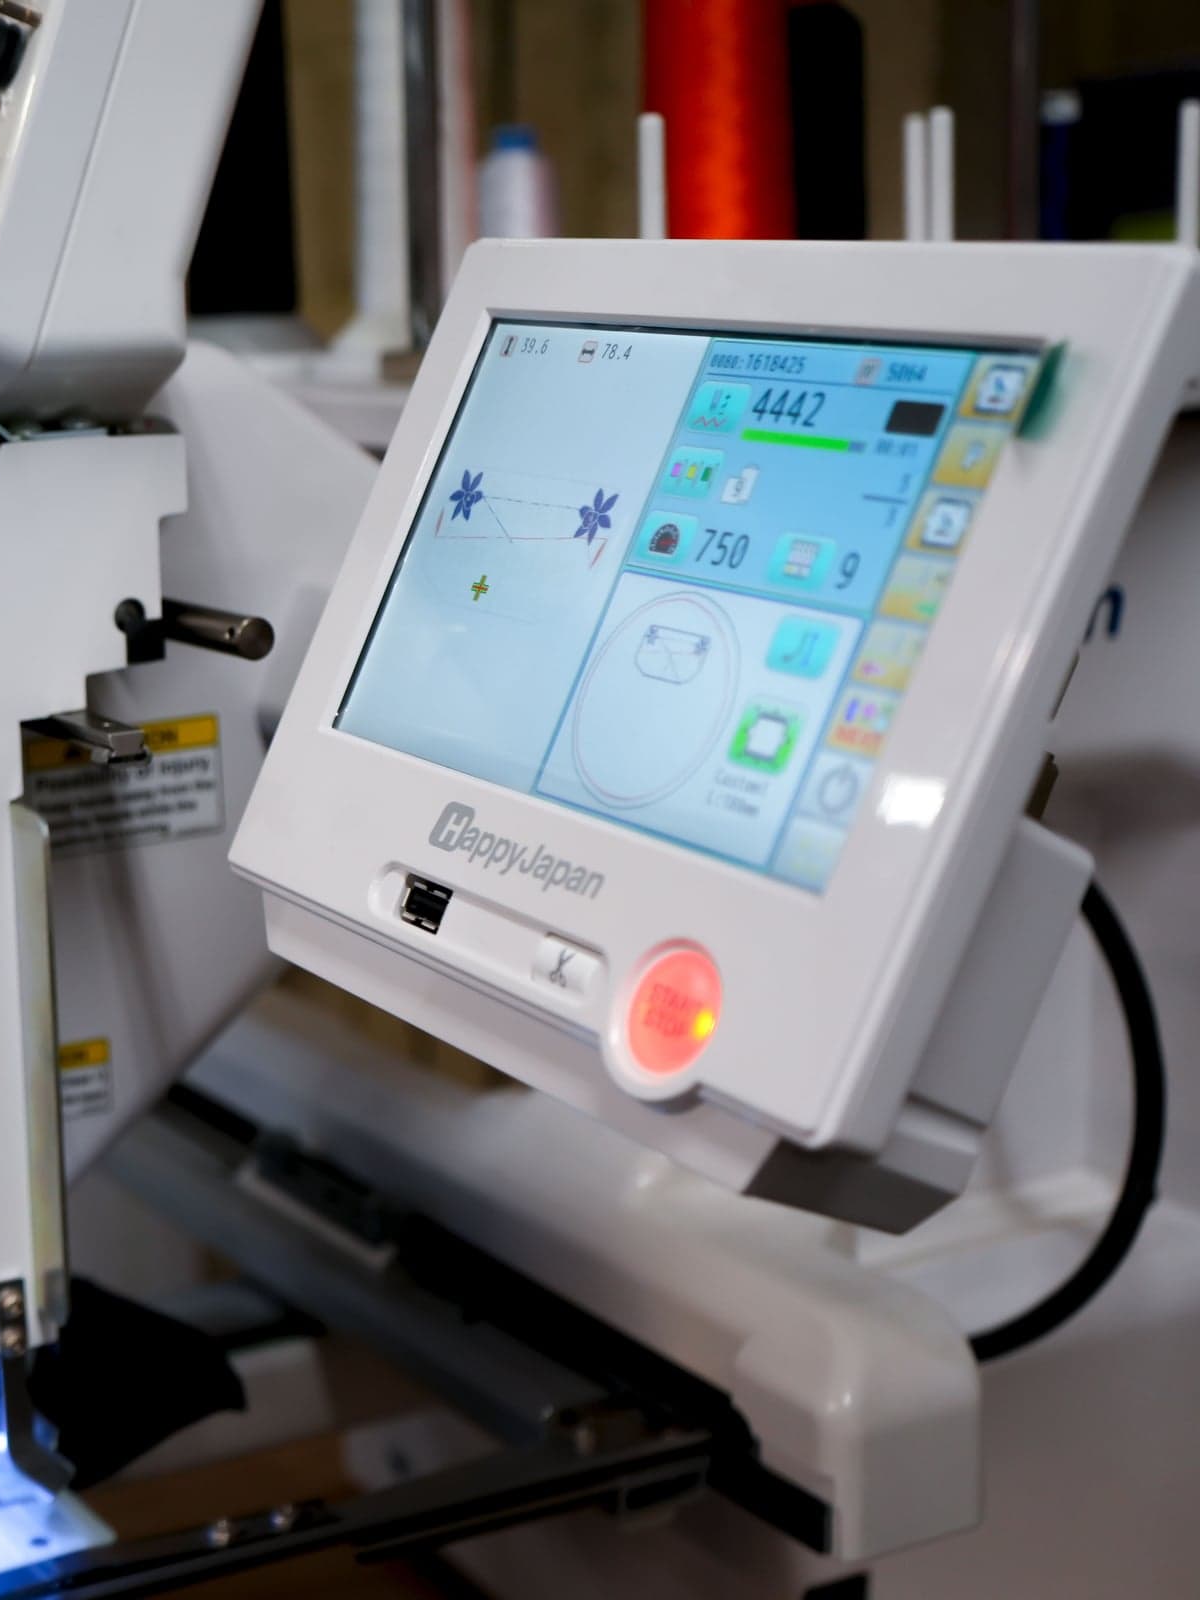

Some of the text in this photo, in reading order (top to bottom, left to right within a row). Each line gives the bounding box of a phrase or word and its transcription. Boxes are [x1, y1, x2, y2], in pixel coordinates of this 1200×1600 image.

[521, 337, 550, 355] 39.6
[601, 343, 633, 361] 78.4
[752, 388, 827, 427] 4442
[695, 528, 750, 570] 750
[835, 552, 861, 590] 9
[428, 801, 605, 900] HappyJapan
